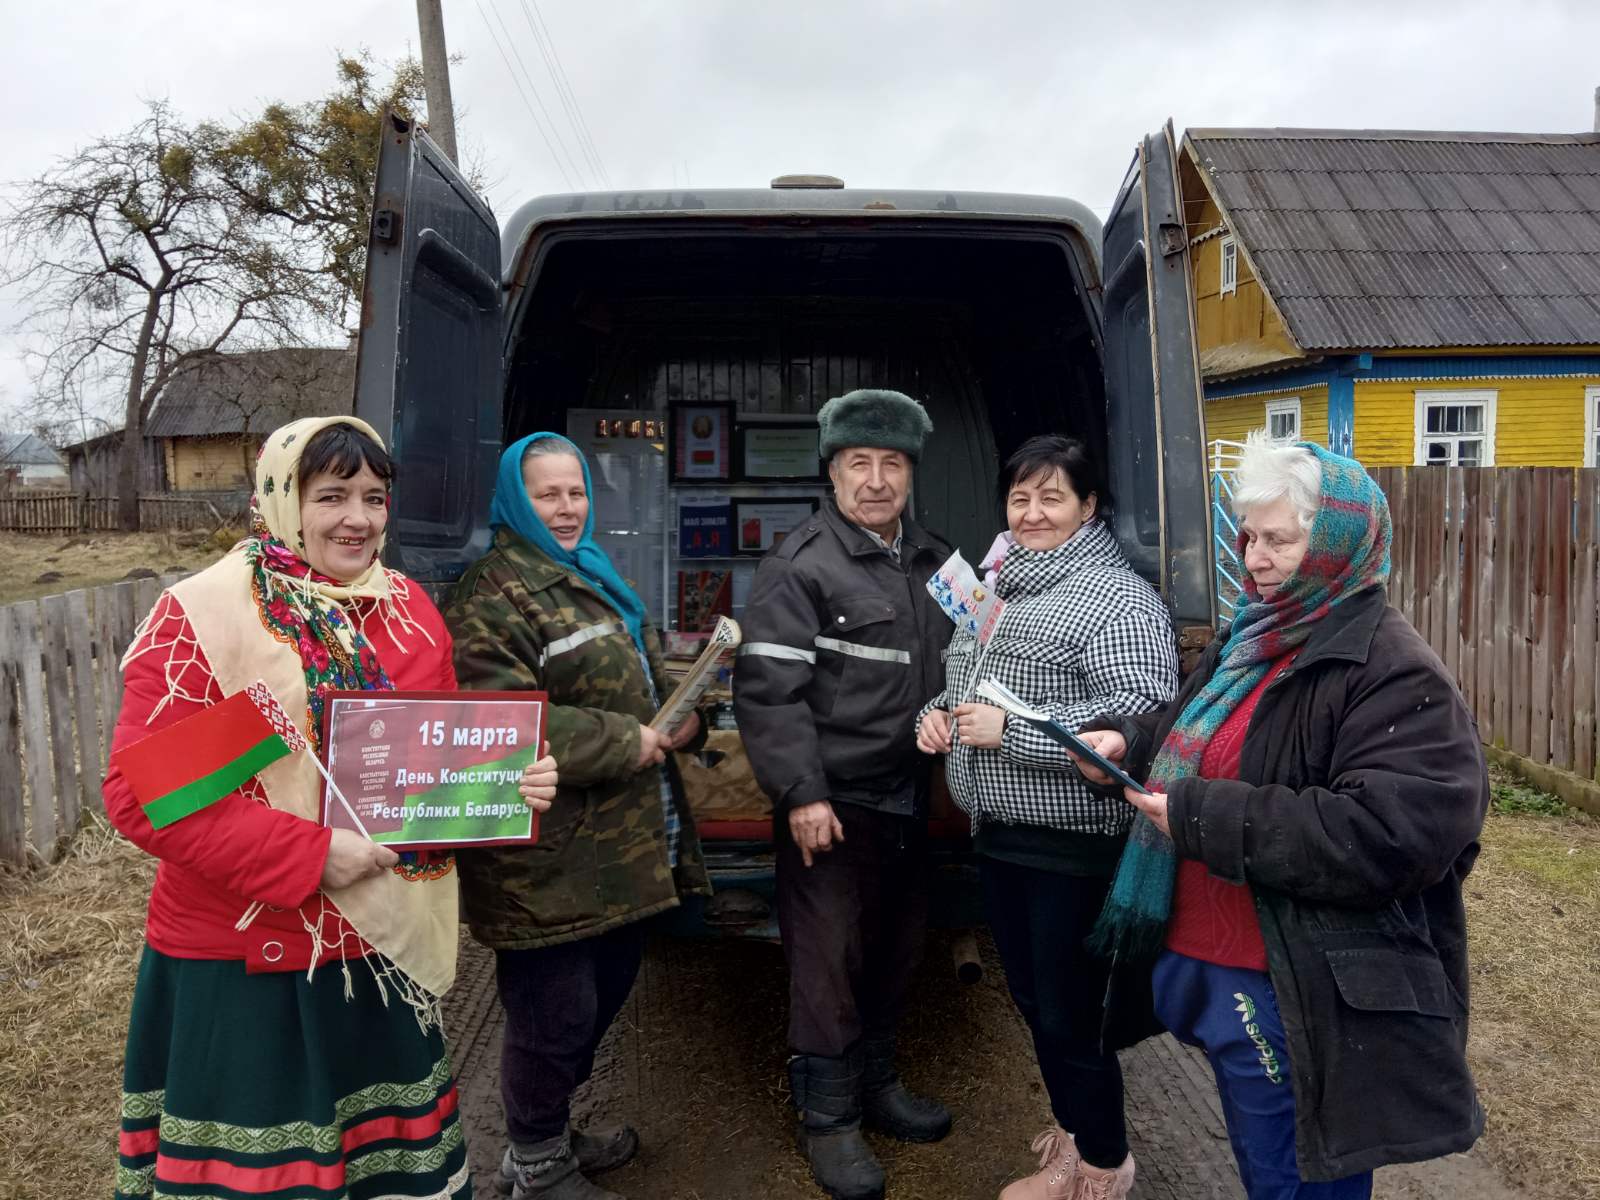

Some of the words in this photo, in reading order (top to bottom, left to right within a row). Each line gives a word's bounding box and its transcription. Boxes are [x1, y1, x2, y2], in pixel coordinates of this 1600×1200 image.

[419, 721, 445, 746] 15
[453, 726, 518, 751] марта
[395, 768, 434, 787] День
[440, 768, 525, 785] Конституци
[372, 803, 460, 822] Республики
[1246, 1023, 1282, 1084] adidas
